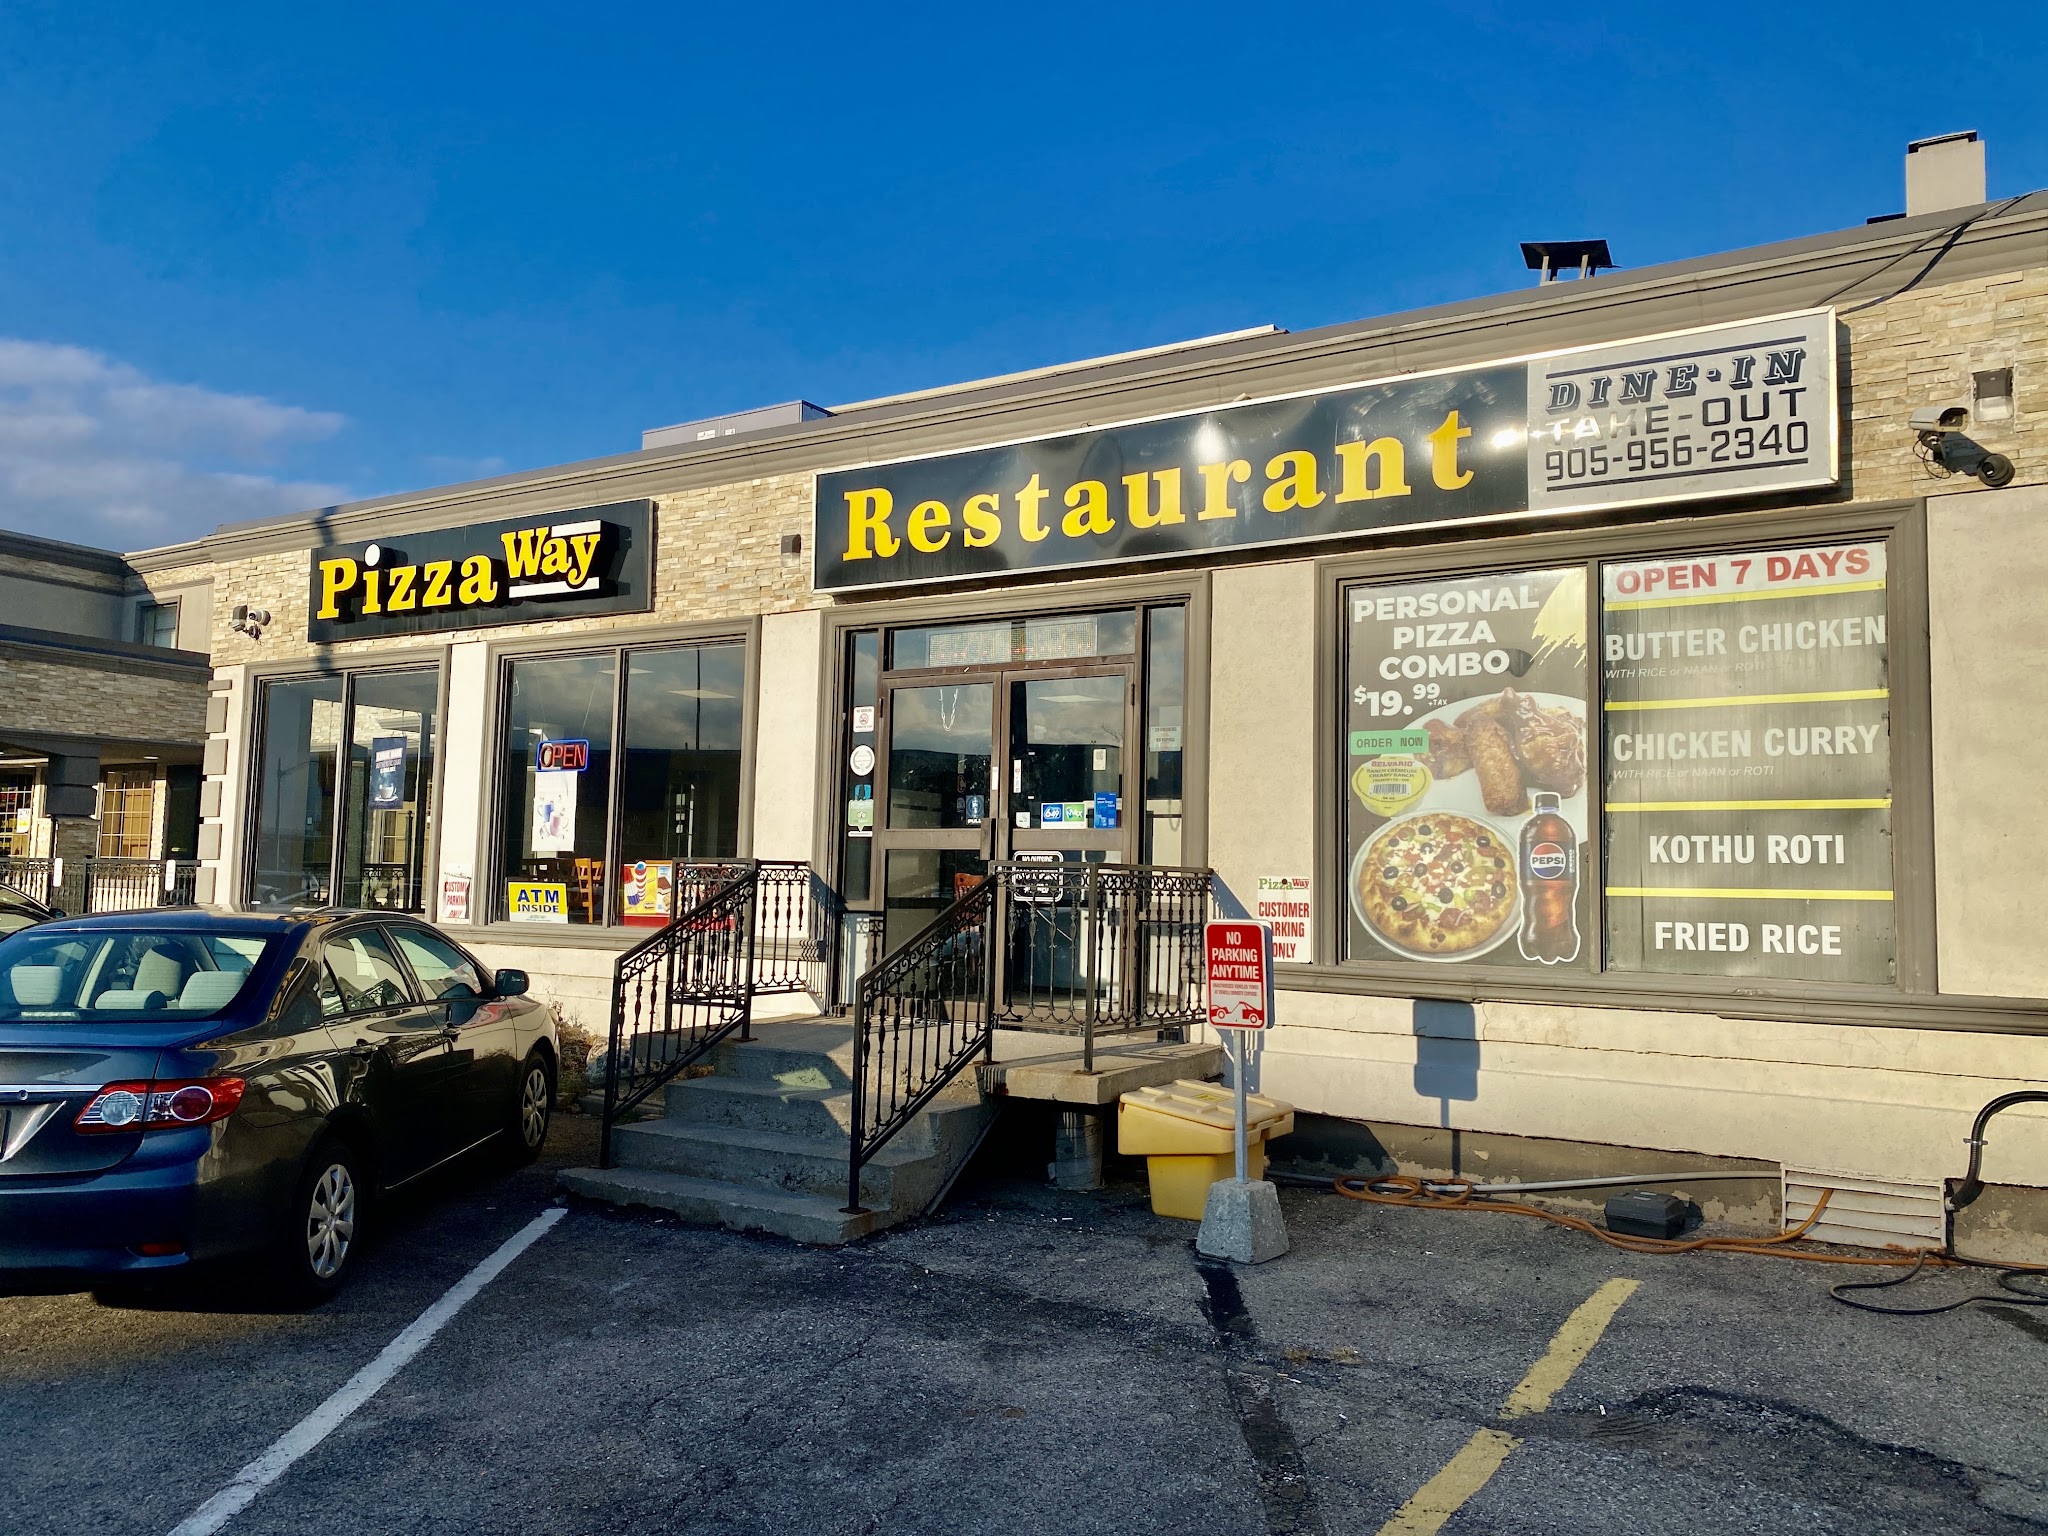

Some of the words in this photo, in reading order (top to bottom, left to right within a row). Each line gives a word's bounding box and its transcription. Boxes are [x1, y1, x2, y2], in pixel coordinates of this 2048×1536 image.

[1546, 387, 1807, 445] TAKE-OUT
[1546, 421, 1808, 481] 905-956-2340
[842, 411, 1474, 562] Restaurant
[316, 543, 498, 620] Pizza
[501, 527, 600, 585] Way
[1616, 563, 1717, 594] OPEN
[1731, 560, 1752, 584] 7
[1767, 549, 1870, 582] DAYS
[1354, 585, 1539, 623] PERSONAL
[1393, 620, 1496, 650] PIZZA
[1605, 627, 1727, 662] BUTTER
[1739, 615, 1886, 653] CHICKEN
[1379, 649, 1510, 681] COMBO
[1605, 669, 1635, 679] WITH
[1638, 668, 1667, 678] RICE
[1670, 668, 1681, 676] or
[1684, 665, 1717, 675] NAAN
[1735, 662, 1765, 672] ROTI
[1356, 738, 1392, 748] ORDER
[1400, 737, 1423, 747] NOW
[1614, 729, 1751, 762] CHICKEN
[1764, 725, 1880, 757] CURRY
[539, 743, 586, 768] OPEN
[1613, 769, 1643, 779] WITH
[1646, 768, 1675, 778] RICE
[1677, 769, 1689, 778] or
[1692, 767, 1726, 777] NAAN
[1729, 767, 1741, 776] or
[1744, 765, 1774, 776] ROTI
[1650, 835, 1755, 864] KOTHU
[1768, 835, 1845, 864] ROTI
[1532, 857, 1564, 865] PEPSI
[444, 881, 468, 892] CUSTOM
[1292, 879, 1310, 889] Way
[447, 895, 465, 906] PARKIN
[517, 889, 559, 903] ATM
[518, 904, 559, 913] INSIDE
[1258, 902, 1310, 918] CUSTOMER
[1270, 921, 1304, 937] ARKING
[1226, 931, 1242, 945] NO
[1655, 921, 1750, 952] FRIED
[1762, 924, 1842, 955] RICE
[1211, 948, 1258, 962] PARKING
[1273, 943, 1296, 958] ONLY
[1211, 964, 1259, 979] ANYTIME
